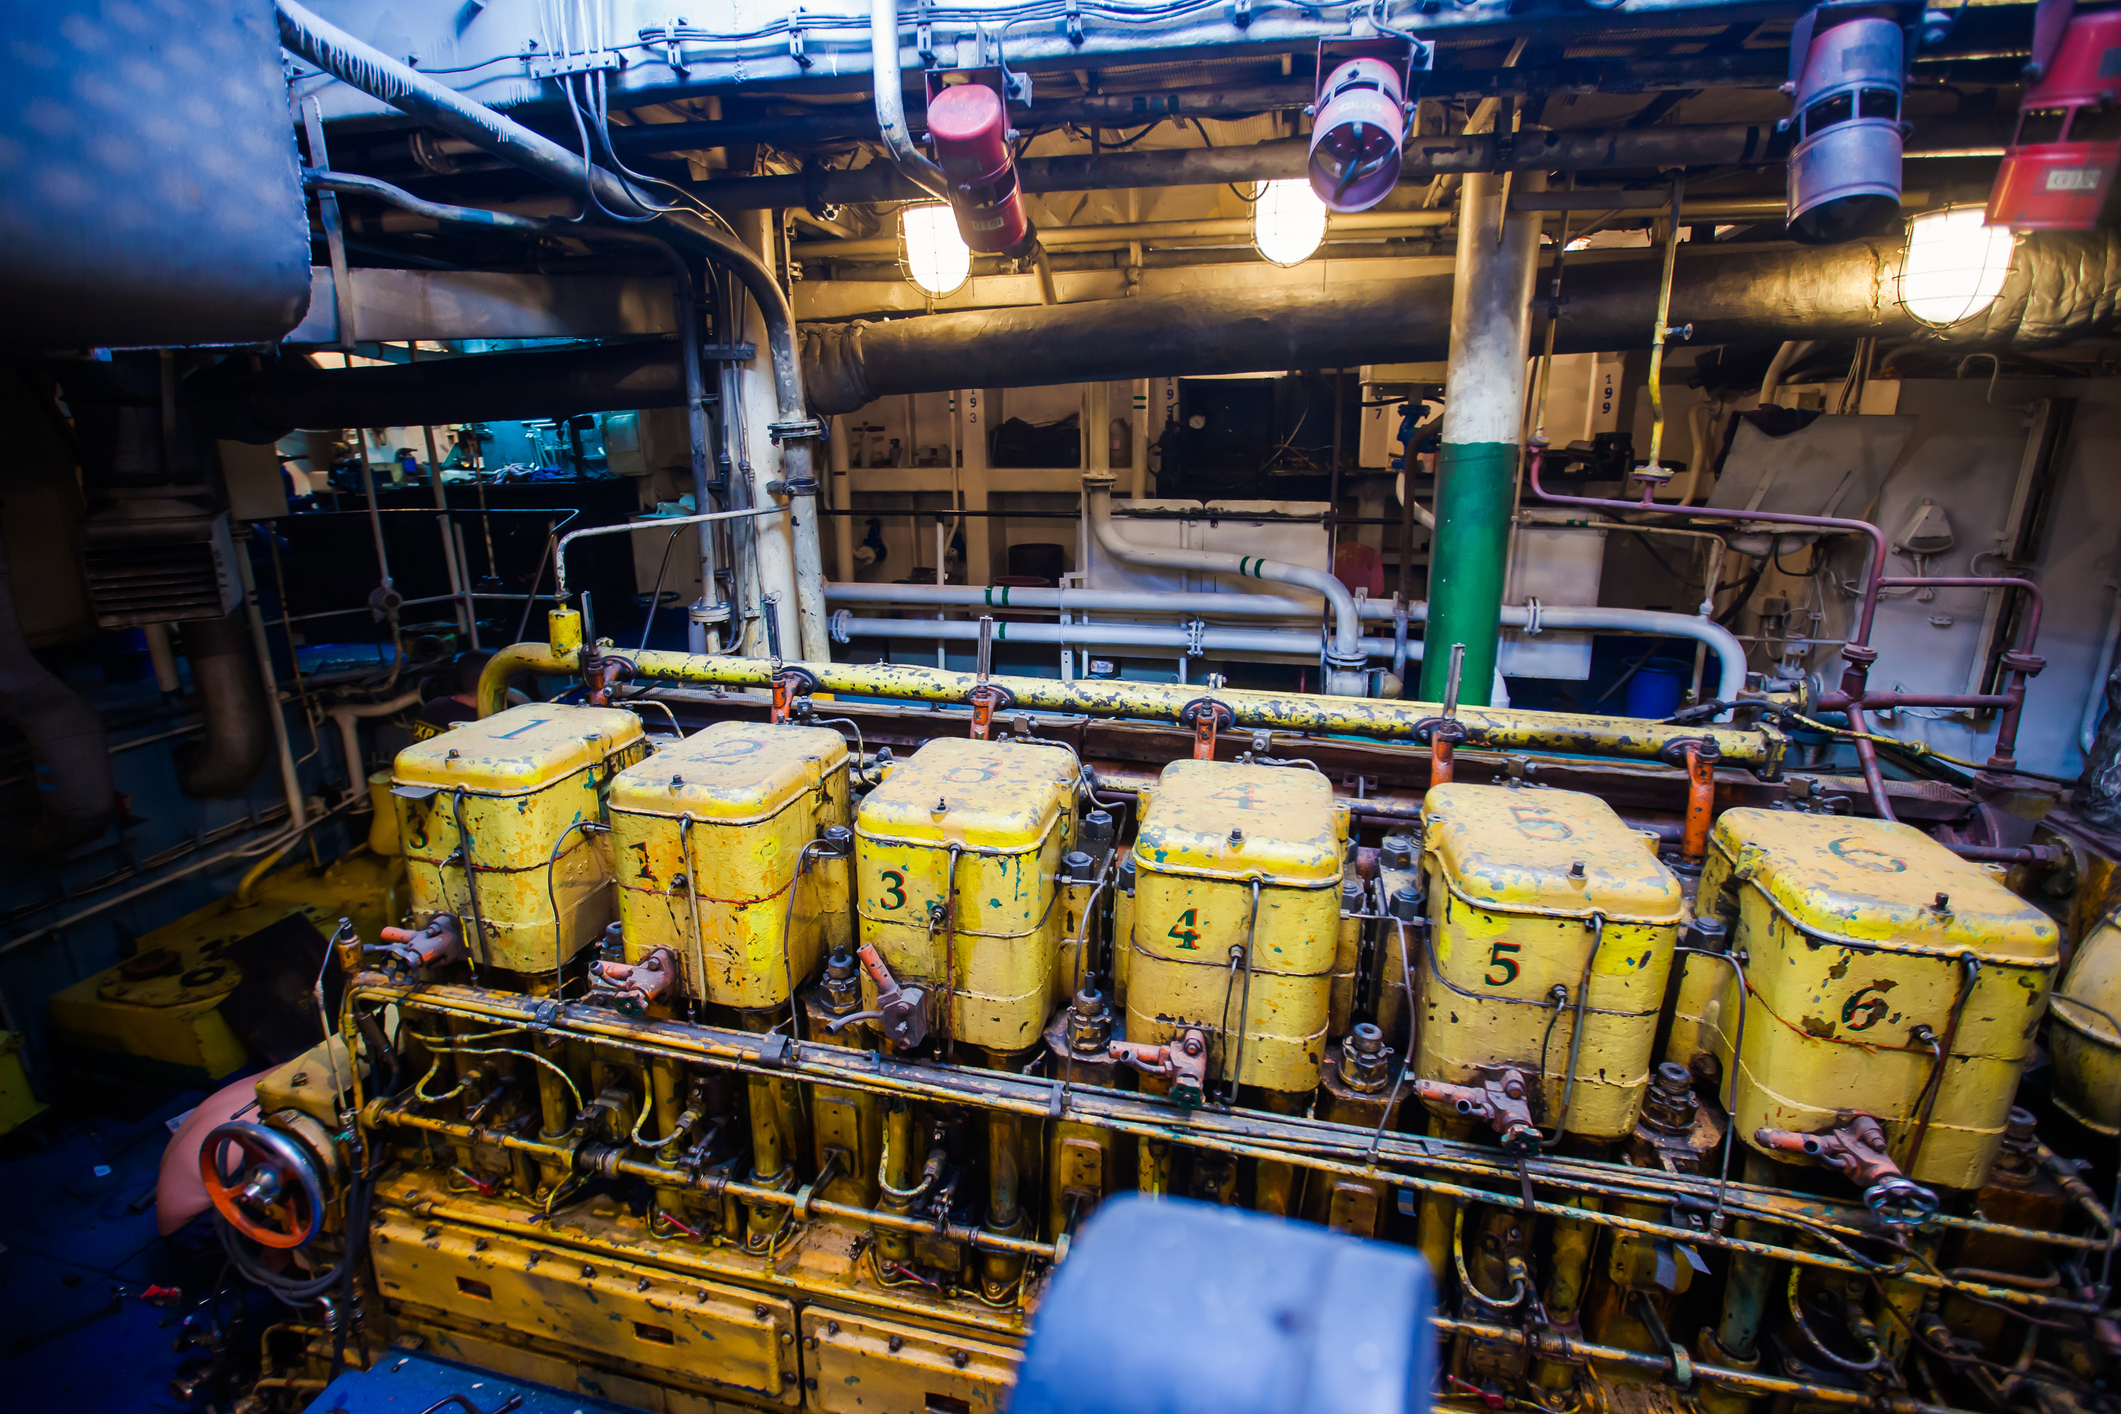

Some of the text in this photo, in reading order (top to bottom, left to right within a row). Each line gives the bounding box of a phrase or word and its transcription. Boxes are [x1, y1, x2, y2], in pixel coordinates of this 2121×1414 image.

[1602, 373, 1613, 414] 199
[486, 718, 553, 740] 1
[686, 739, 767, 766] 2
[942, 756, 1004, 784] 3
[1210, 782, 1268, 811] 4
[407, 813, 430, 850] 3
[1508, 805, 1574, 842] 5
[880, 870, 907, 911] 3
[1167, 908, 1201, 951] 4
[1485, 941, 1521, 987] 5
[1841, 984, 1889, 1032] 6
